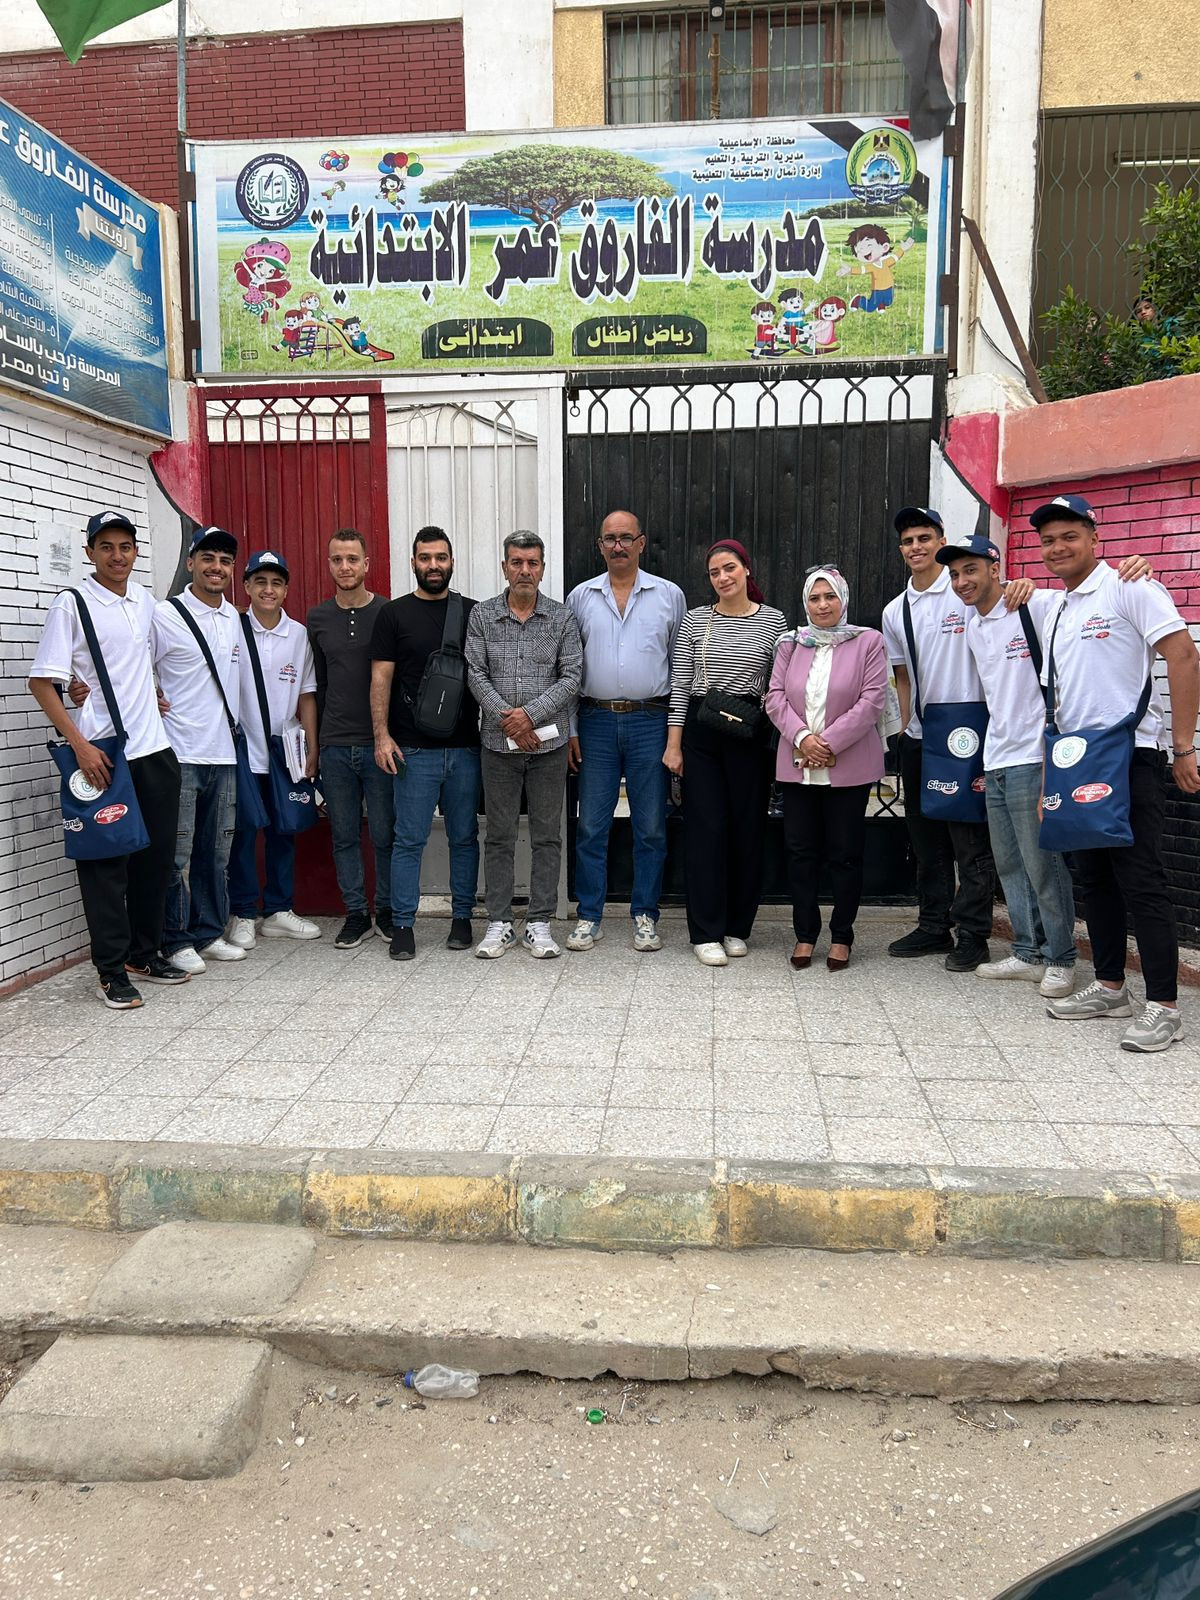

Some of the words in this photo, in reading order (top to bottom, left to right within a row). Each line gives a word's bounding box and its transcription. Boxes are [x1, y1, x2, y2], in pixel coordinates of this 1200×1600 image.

[767, 136, 795, 146] محافظة
[15, 127, 90, 197] الفاروق
[705, 155, 736, 166] والتعليم
[741, 153, 769, 165] التربية
[774, 151, 804, 163] مديرية
[692, 169, 726, 180] التعليمية
[777, 168, 796, 179] شمال
[801, 166, 821, 178] إدارة
[93, 178, 146, 233] مدرسة
[95, 215, 127, 251] رؤيتنا
[704, 195, 824, 293] مدرسة
[310, 202, 467, 304] الابتدائية
[573, 197, 690, 299] الفاروق
[486, 223, 559, 300] عمر
[587, 320, 638, 347] أطفال
[644, 323, 693, 346] رياض
[1, 353, 34, 376] مصر
[44, 349, 77, 370] ترحب
[37, 364, 59, 385] تحيا
[78, 357, 121, 387] المدرسة
[927, 780, 958, 791] Signal
